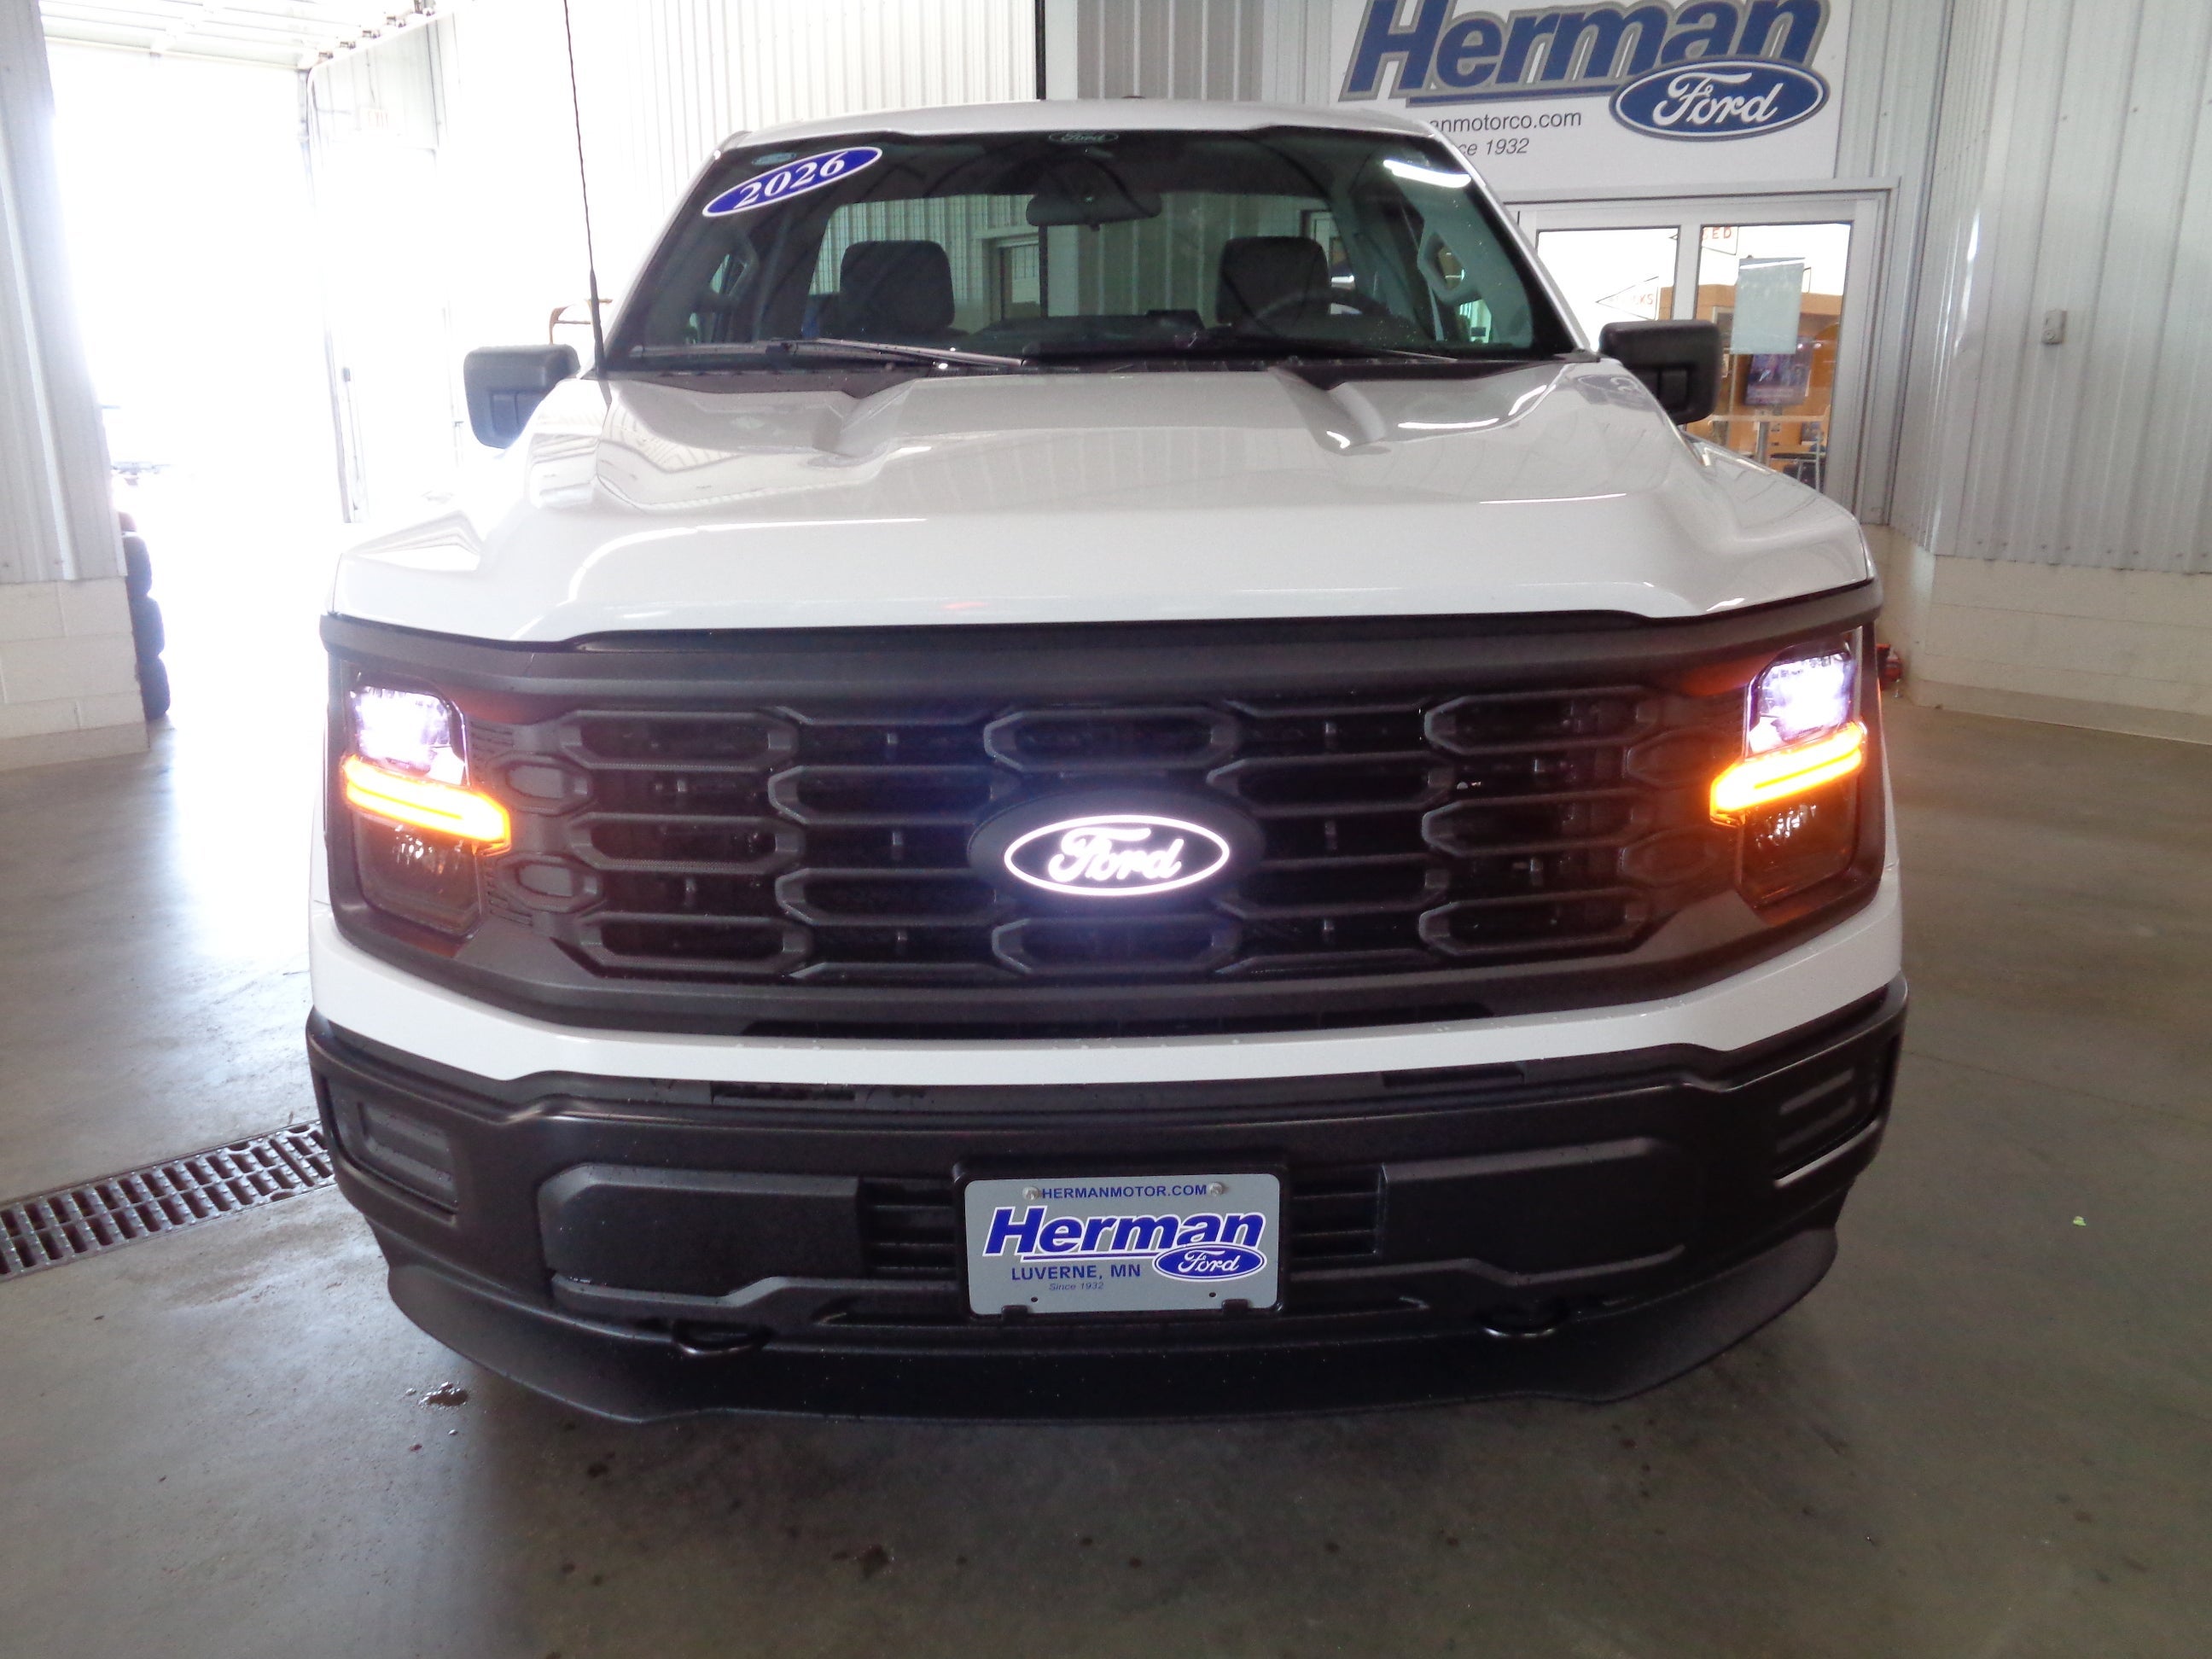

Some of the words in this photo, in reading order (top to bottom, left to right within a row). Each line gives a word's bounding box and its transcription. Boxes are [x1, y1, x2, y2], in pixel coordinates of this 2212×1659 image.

[1339, 0, 1829, 101] Herman
[1652, 72, 1784, 125] Ford
[1429, 112, 1581, 132] anmotorco.com
[1487, 137, 1529, 154] 1932
[733, 151, 849, 209] 2026
[1048, 826, 1185, 882] Ford
[1041, 1185, 1208, 1199] HERMANMOTOR.COM
[982, 1205, 1266, 1257] Herman
[1011, 1265, 1103, 1280] LUVERNE,
[1110, 1264, 1141, 1278] MN
[1178, 1249, 1241, 1272] Ford
[1049, 1283, 1076, 1291] Since
[1080, 1282, 1104, 1290] 1932
